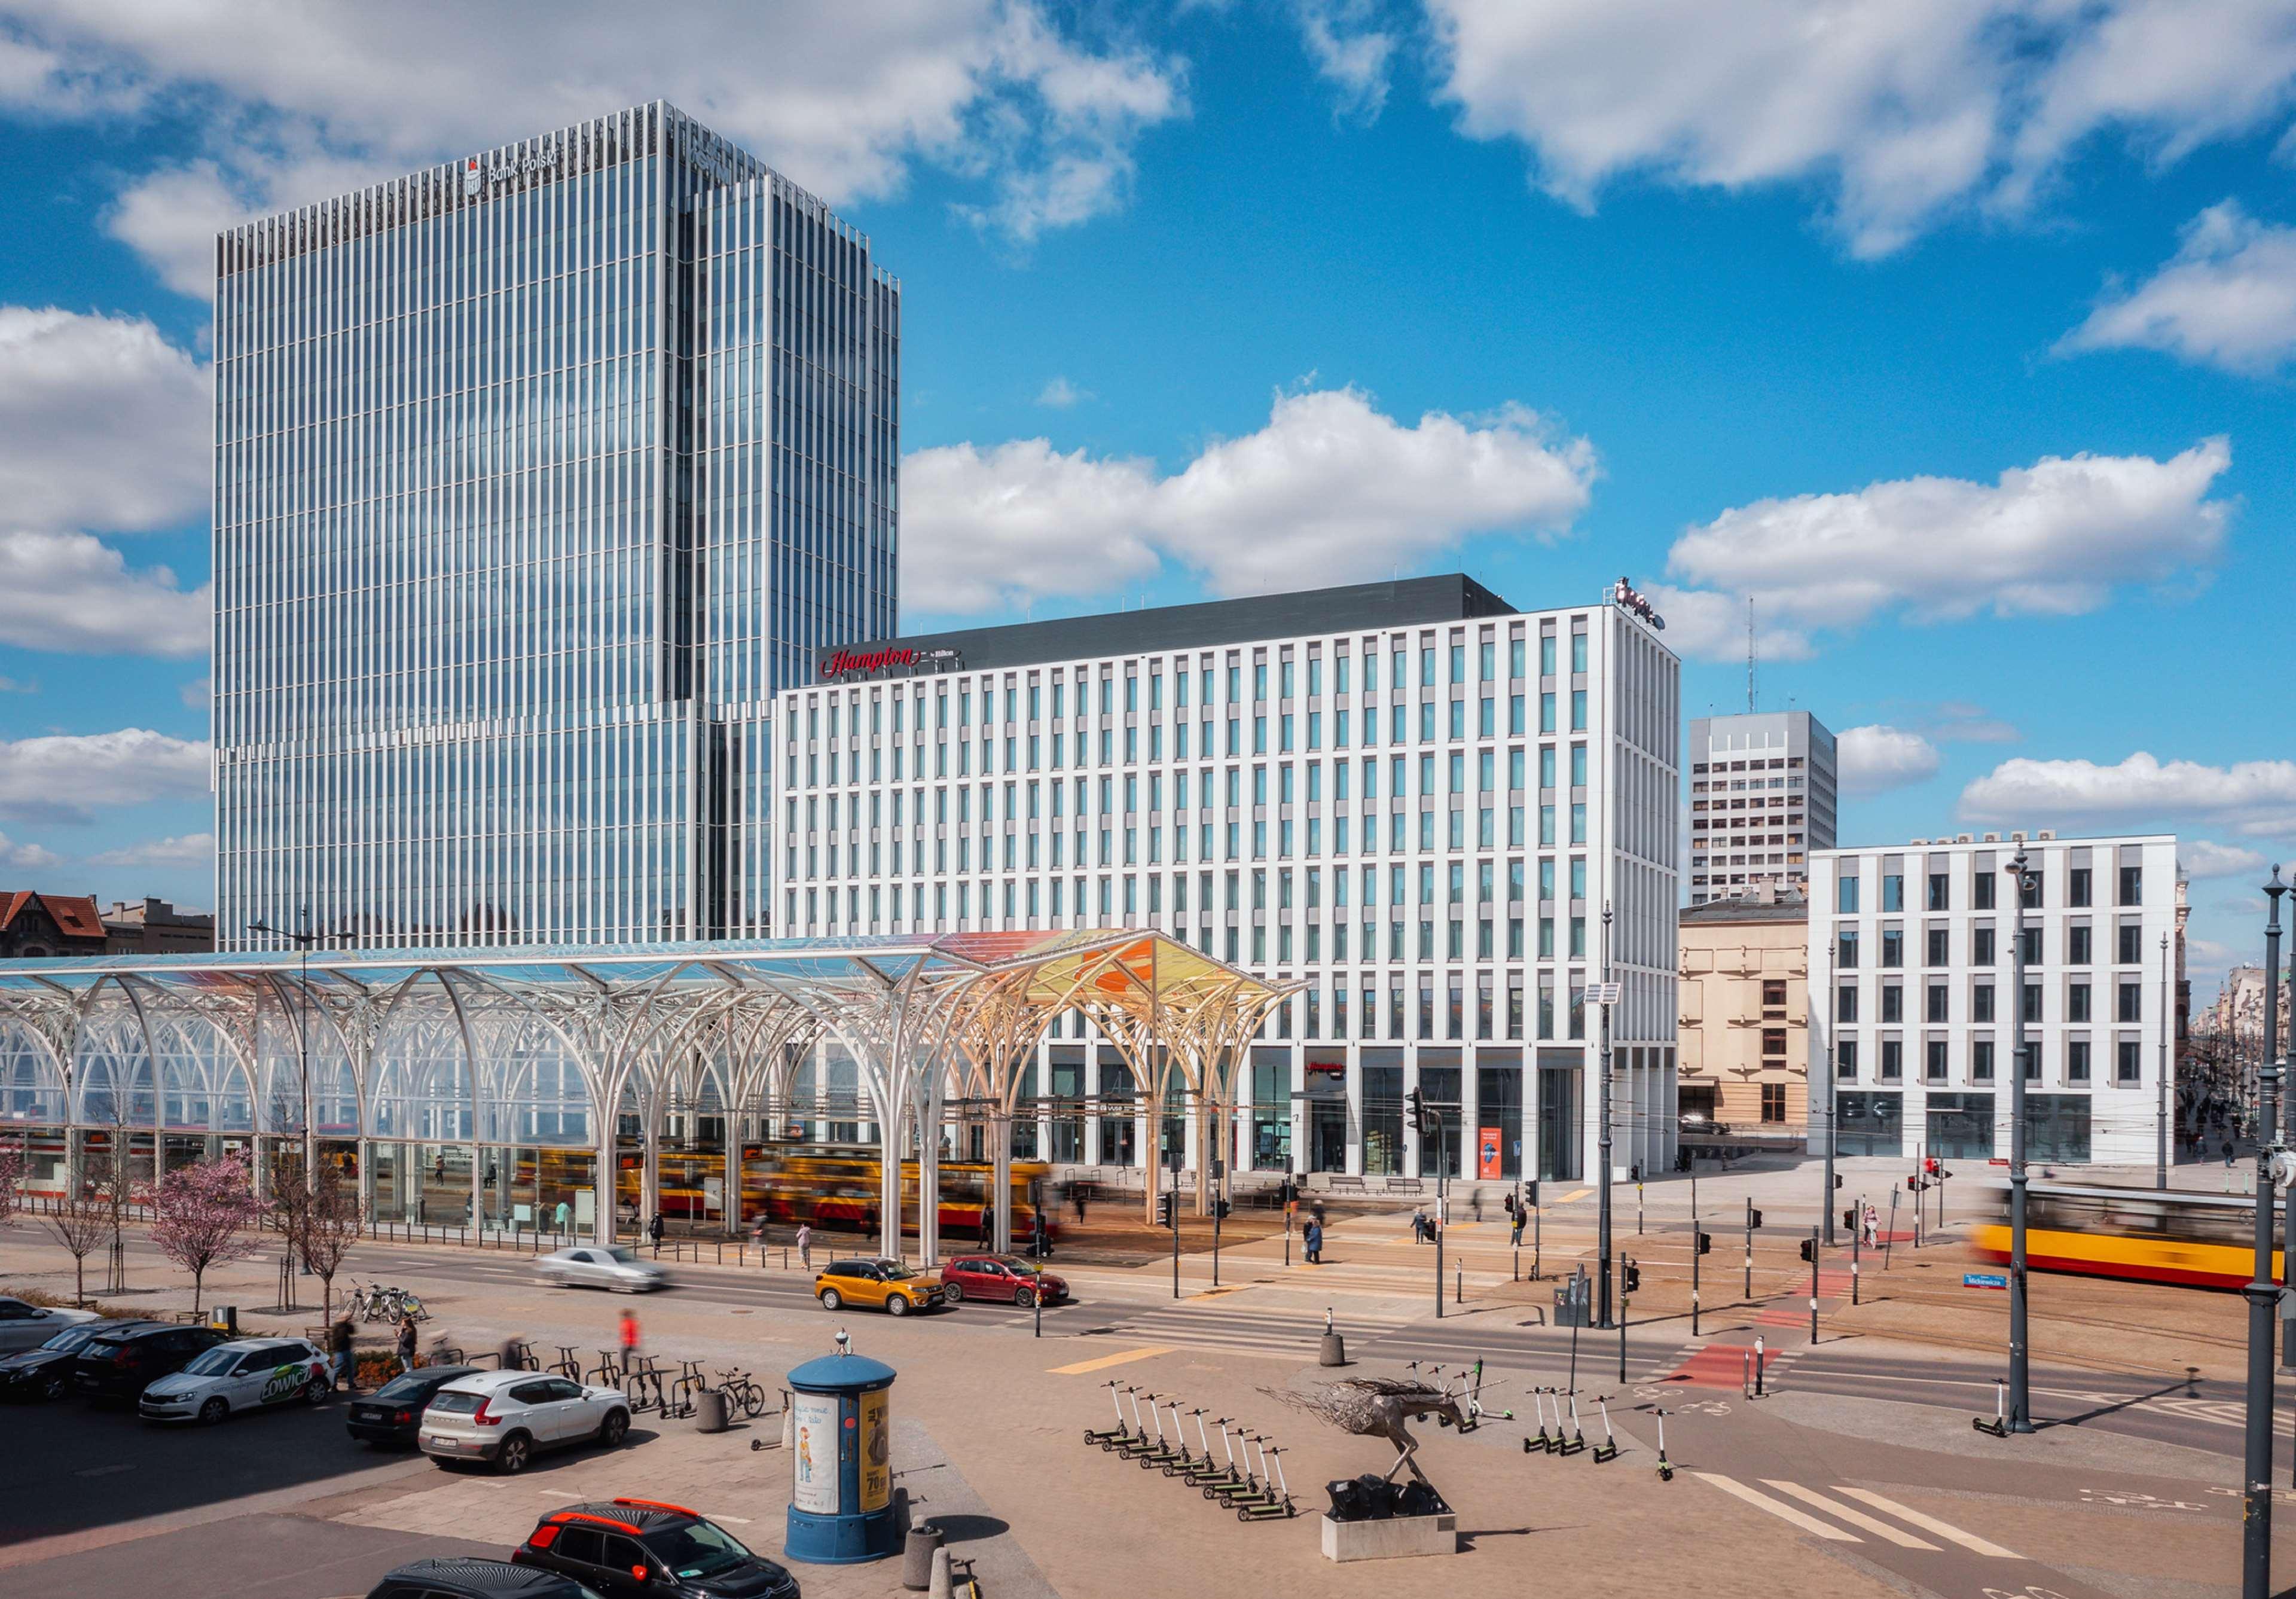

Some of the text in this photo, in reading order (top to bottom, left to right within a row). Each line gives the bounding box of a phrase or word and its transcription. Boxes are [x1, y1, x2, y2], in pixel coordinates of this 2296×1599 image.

[488, 161, 519, 182] Bank
[521, 149, 557, 173] Polski
[820, 646, 921, 679] Hampton
[867, 1475, 880, 1490] 70
